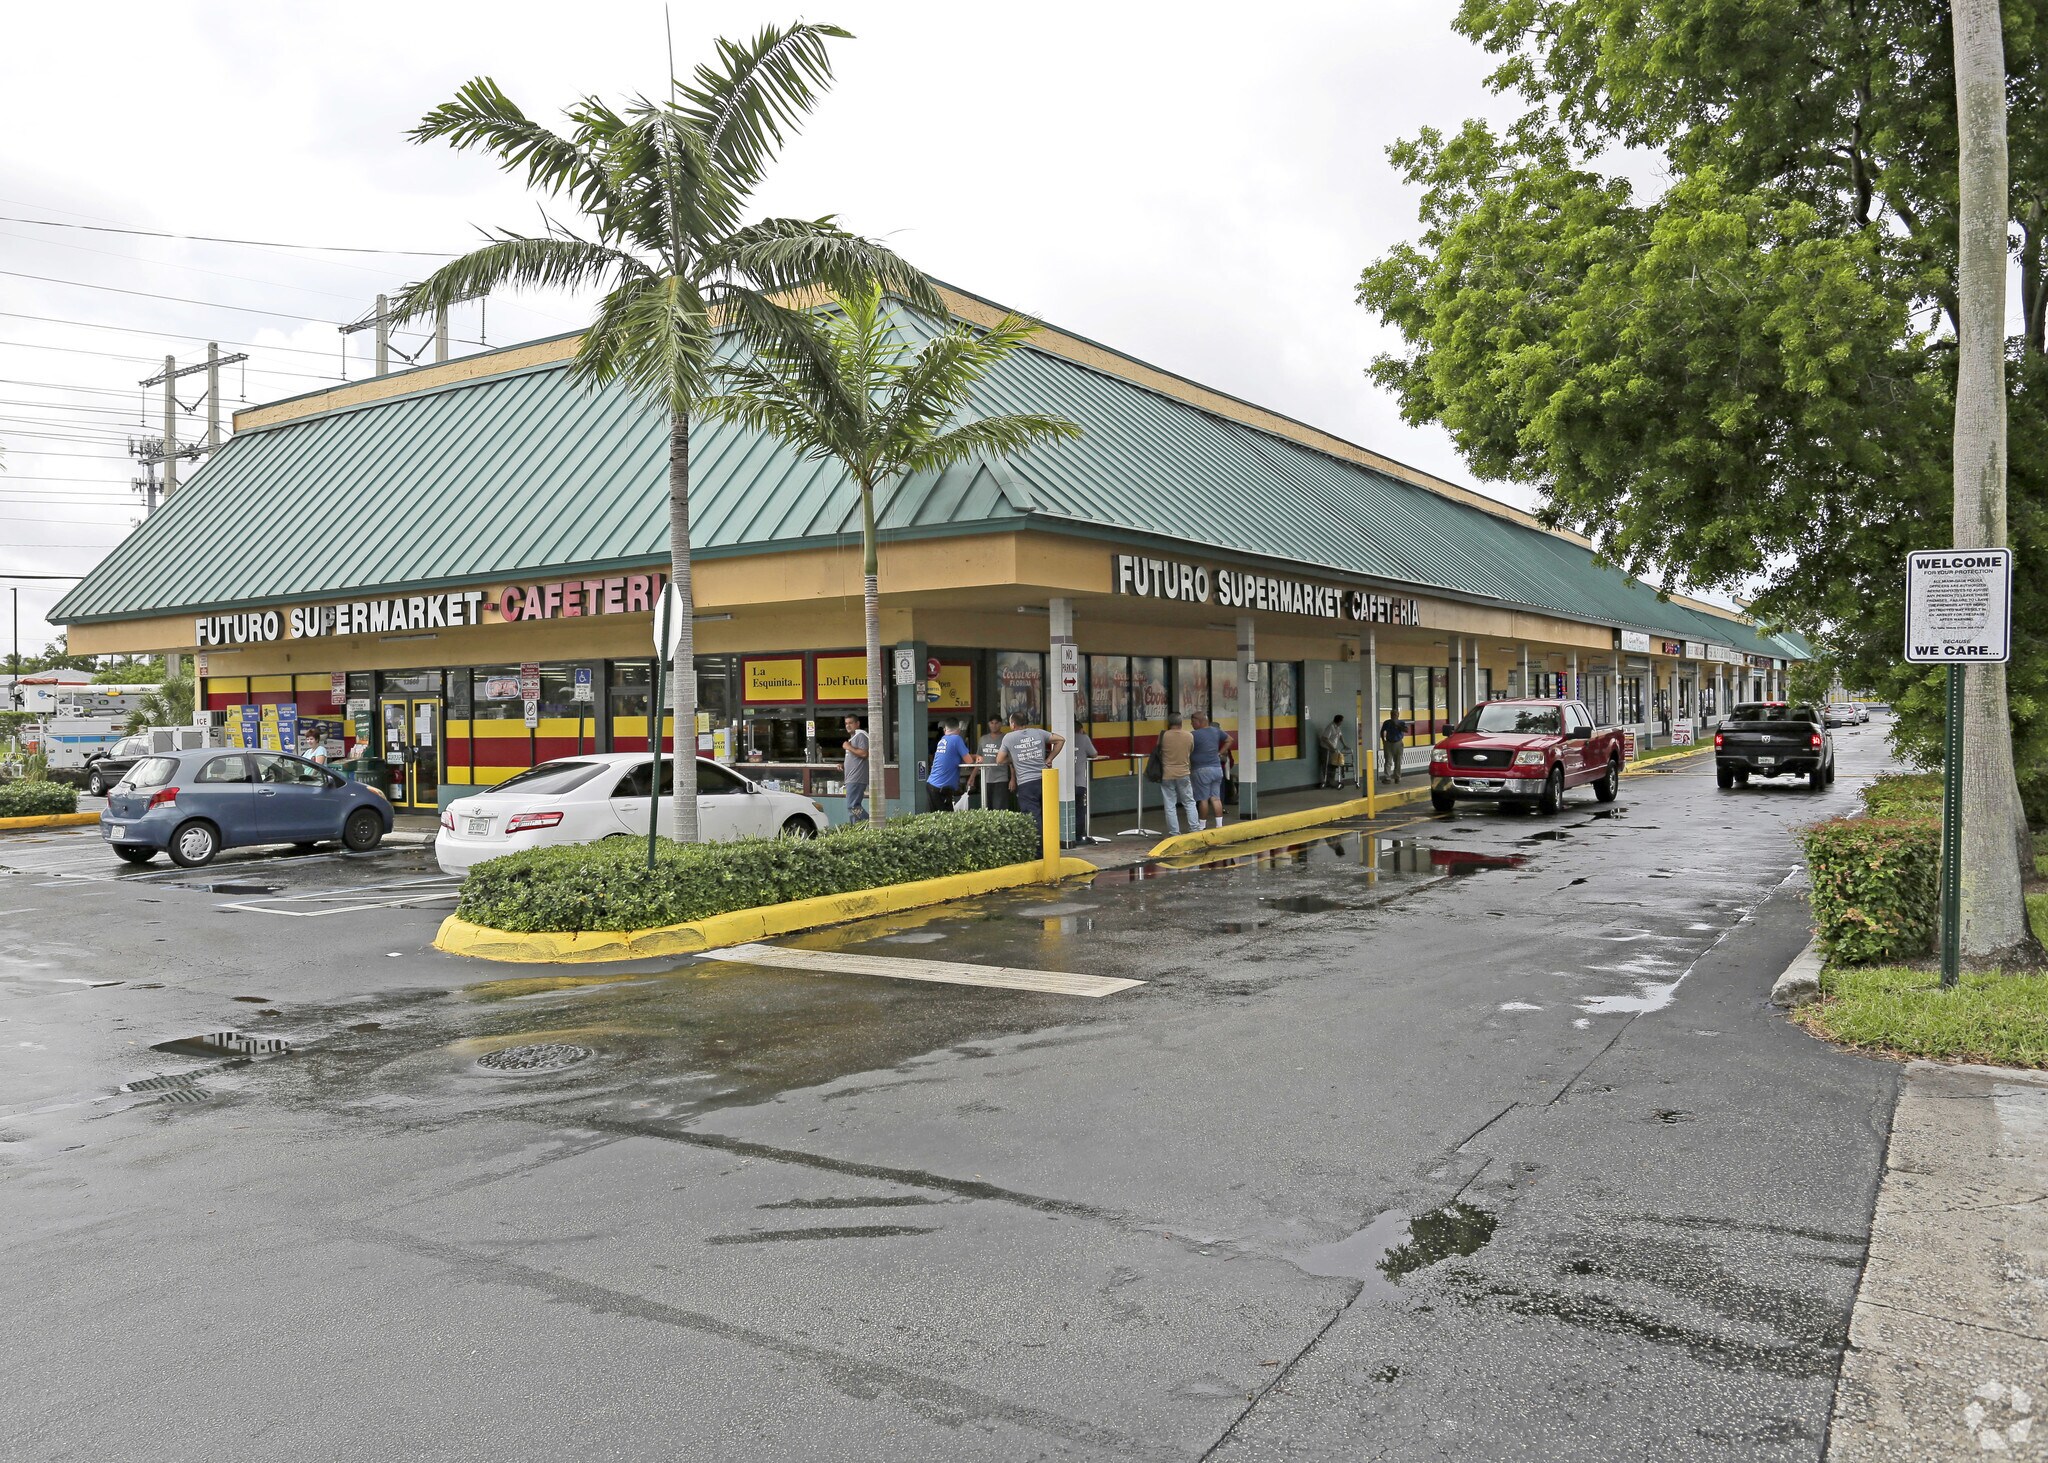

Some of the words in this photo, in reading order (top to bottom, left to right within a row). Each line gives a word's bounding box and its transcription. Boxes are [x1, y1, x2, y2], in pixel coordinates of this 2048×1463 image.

[1916, 557, 2002, 569] WELCOME
[1118, 554, 1210, 603] FUTURO
[1217, 569, 1344, 618] SUPERMARKET
[1350, 591, 1420, 626] CAFETERIA
[195, 611, 283, 647] FUTURO
[290, 591, 485, 639] SUPERMARKET
[500, 573, 665, 622] CAFETERI
[1065, 649, 1072, 660] NO
[1915, 646, 1939, 655] WE
[1944, 646, 1999, 655] CARE...
[753, 667, 765, 676] La
[1062, 663, 1078, 672] PARKING
[753, 678, 800, 689] Esquinita...
[842, 676, 868, 686] Futur
